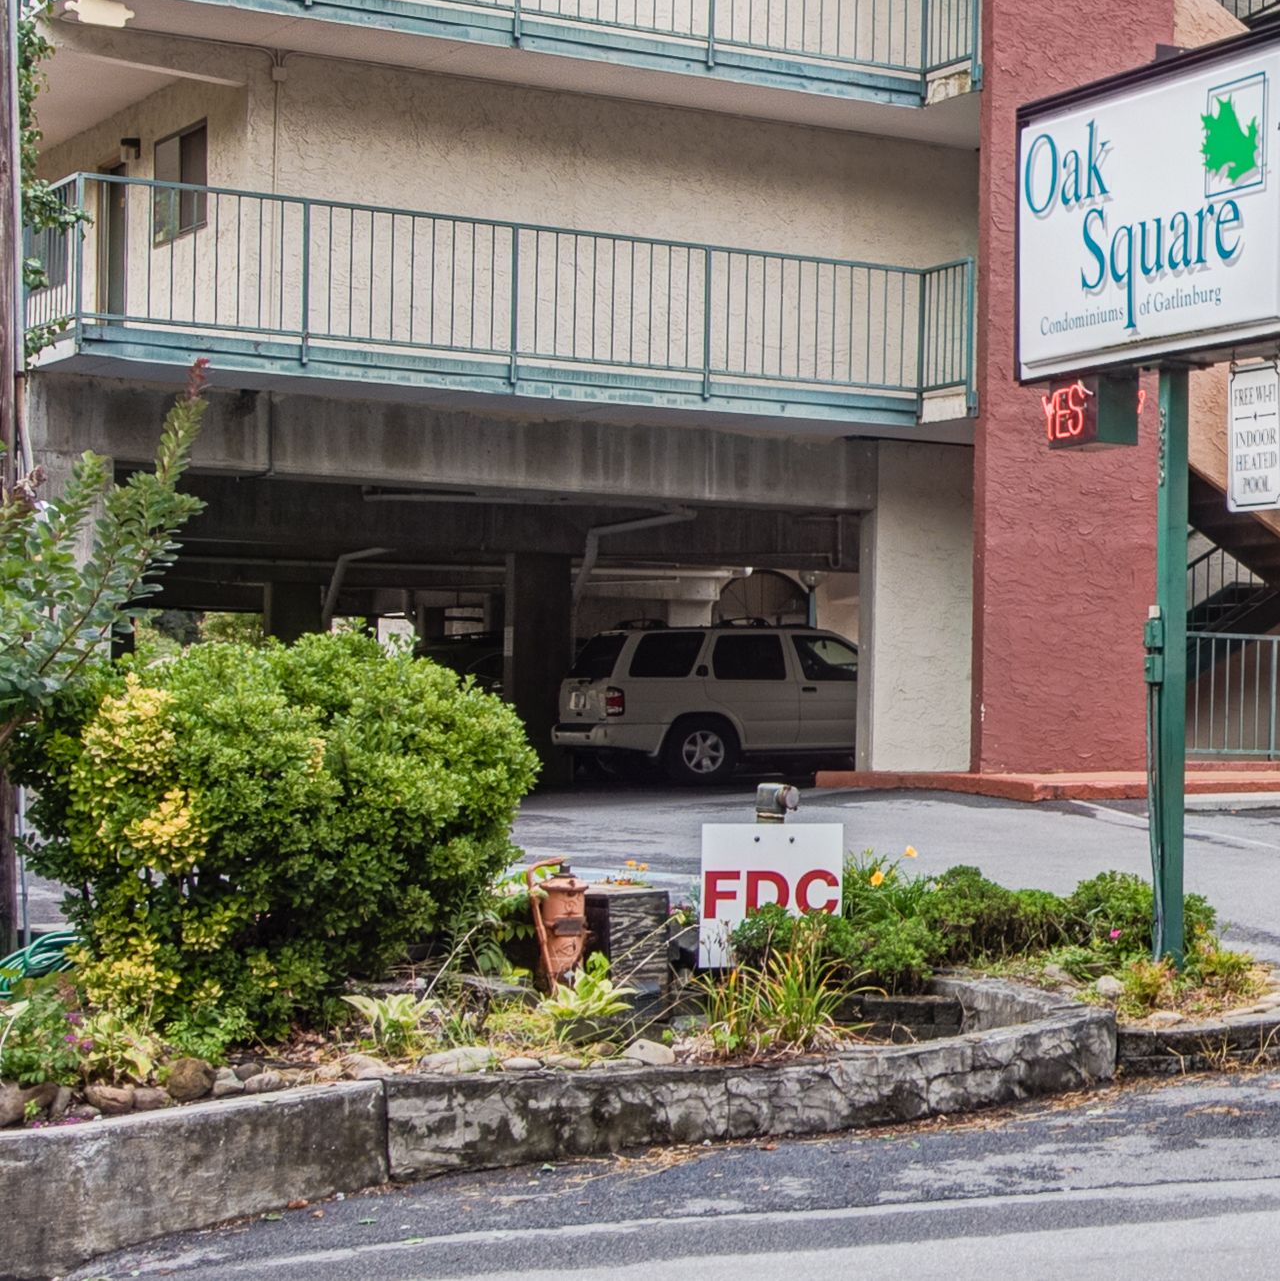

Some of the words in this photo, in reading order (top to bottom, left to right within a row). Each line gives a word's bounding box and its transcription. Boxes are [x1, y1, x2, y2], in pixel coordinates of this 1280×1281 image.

[1023, 119, 1111, 215] Oak
[1081, 198, 1242, 330] Square
[1040, 306, 1124, 336] Condominiums
[1139, 293, 1151, 316] of
[1154, 285, 1222, 313] Gatlinburg
[1041, 384, 1085, 440] YES
[1234, 387, 1254, 407] FREE
[1255, 383, 1277, 404] WI-FI
[1235, 427, 1277, 449] INDOOR
[1235, 451, 1278, 472] HEATED
[1242, 475, 1272, 495] POOL
[703, 869, 840, 919] FDC
